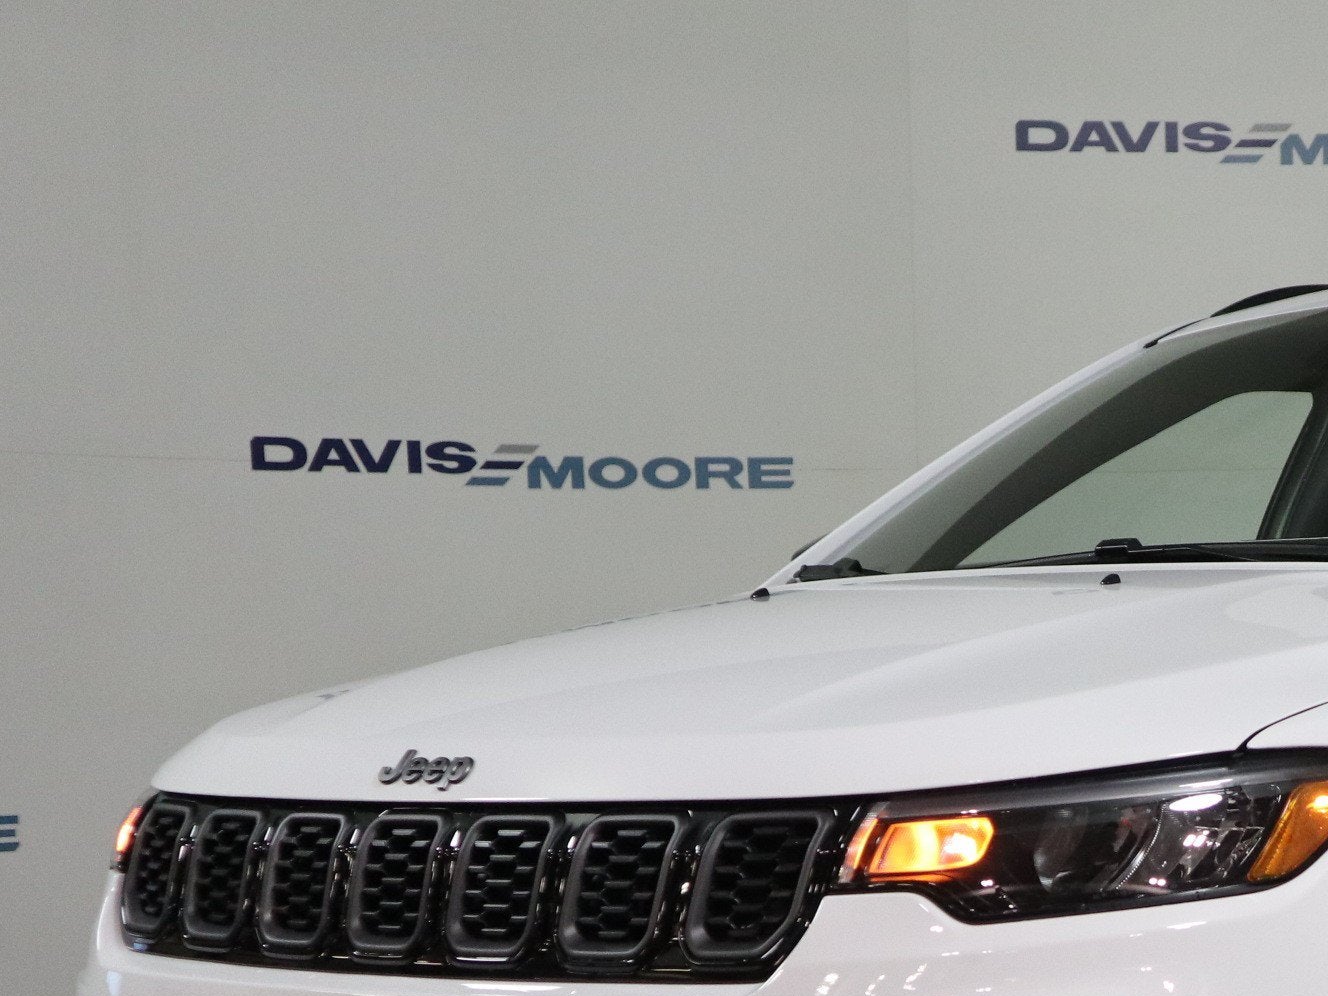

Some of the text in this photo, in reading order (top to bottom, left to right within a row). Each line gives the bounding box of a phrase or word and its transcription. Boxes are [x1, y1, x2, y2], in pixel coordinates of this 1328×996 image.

[1014, 119, 1232, 153] DAVIS
[250, 436, 795, 490] DAVIS MOORE
[378, 749, 475, 791] Jeep
